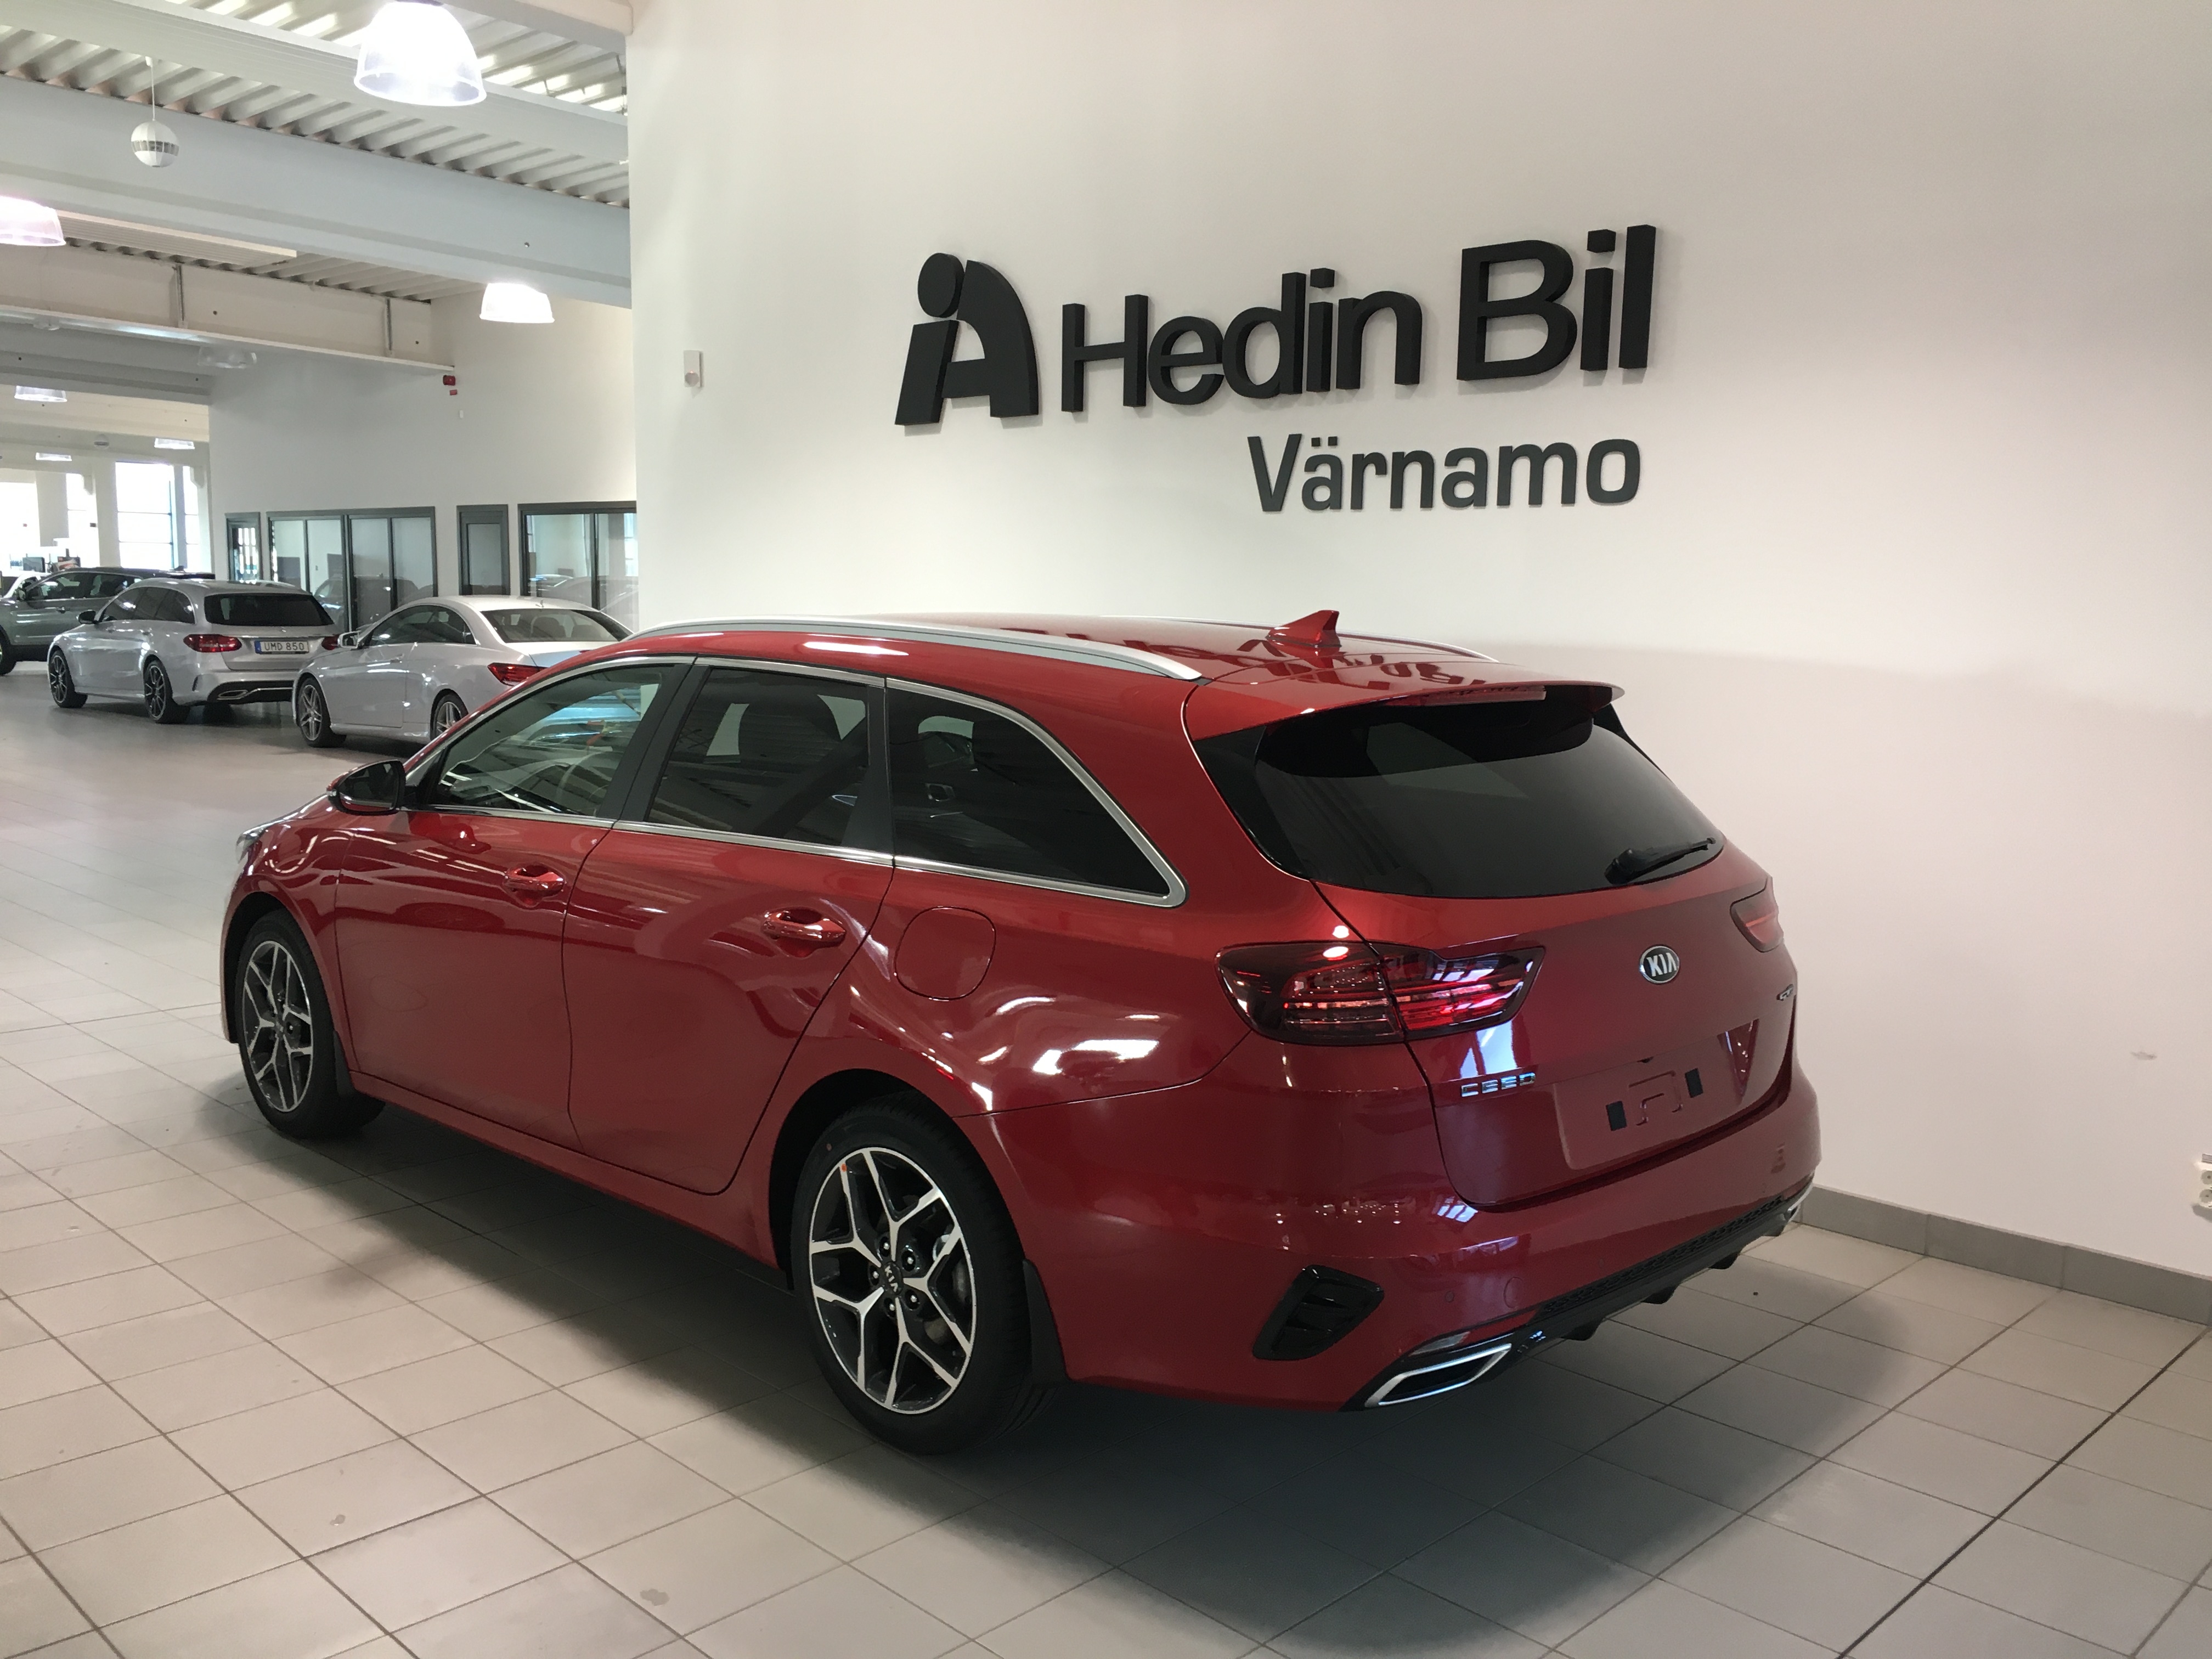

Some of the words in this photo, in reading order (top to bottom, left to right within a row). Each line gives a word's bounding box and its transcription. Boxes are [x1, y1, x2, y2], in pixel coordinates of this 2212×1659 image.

[1062, 268, 1423, 413] Hedin
[1457, 224, 1657, 382] Bil
[1248, 434, 1641, 512] Värnamo
[264, 642, 283, 651] UMD
[286, 642, 305, 651] 850
[1646, 952, 1677, 977] KIA
[1461, 1072, 1536, 1097] CEED
